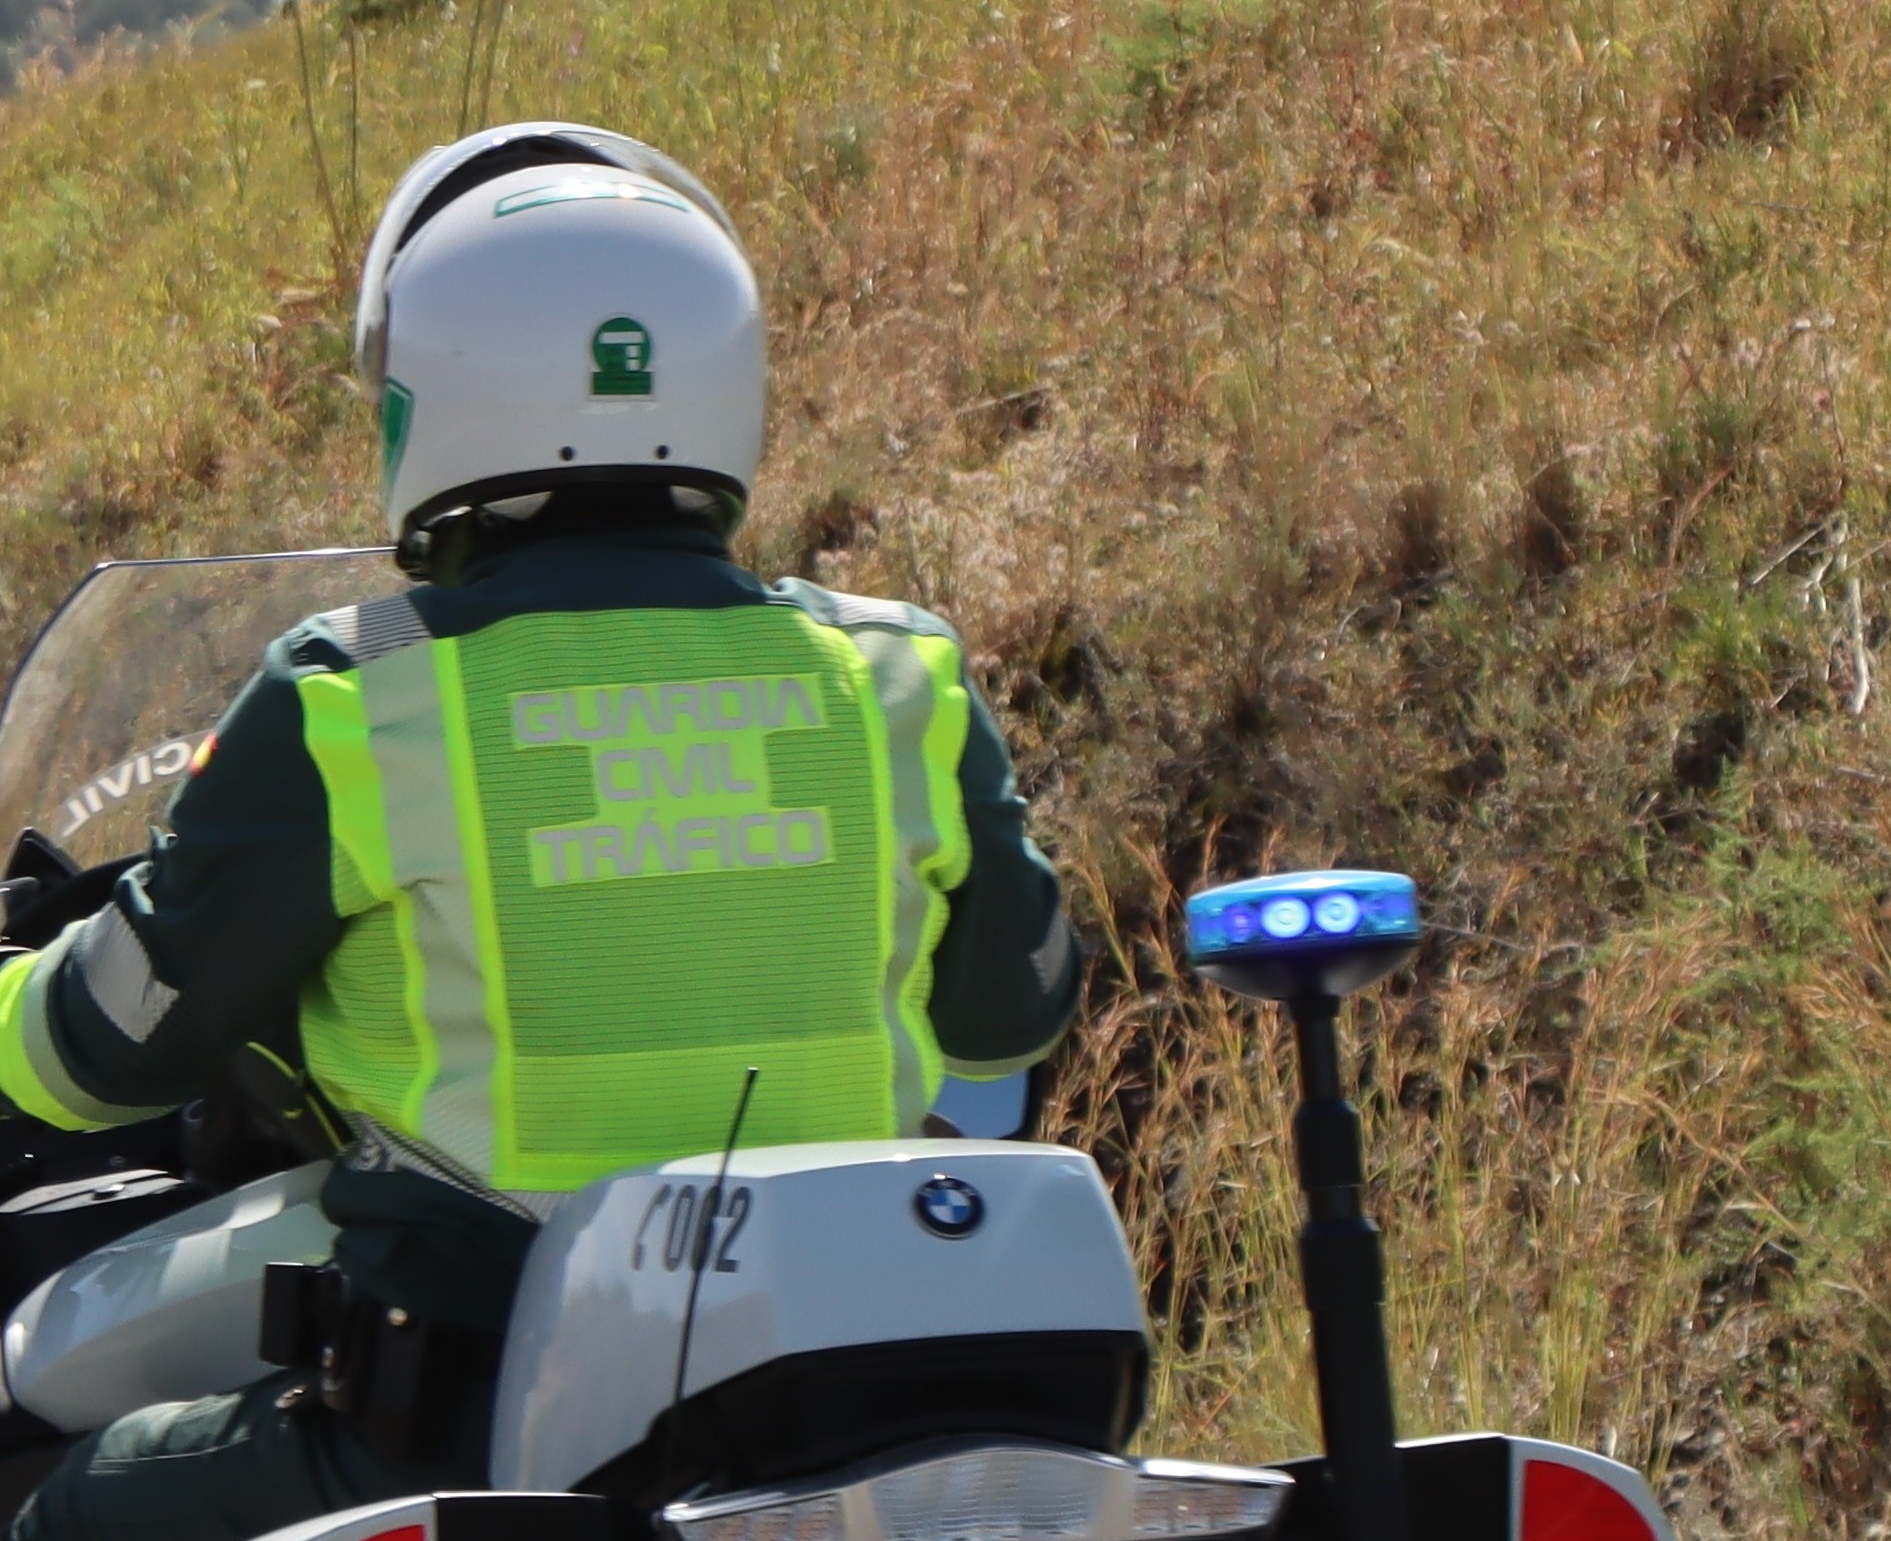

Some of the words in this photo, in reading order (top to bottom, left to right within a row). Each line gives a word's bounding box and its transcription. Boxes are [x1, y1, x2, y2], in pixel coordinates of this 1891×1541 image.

[513, 679, 819, 743] GUARDIA
[598, 743, 756, 801] CIVIL
[534, 808, 825, 883] TRÁFICO
